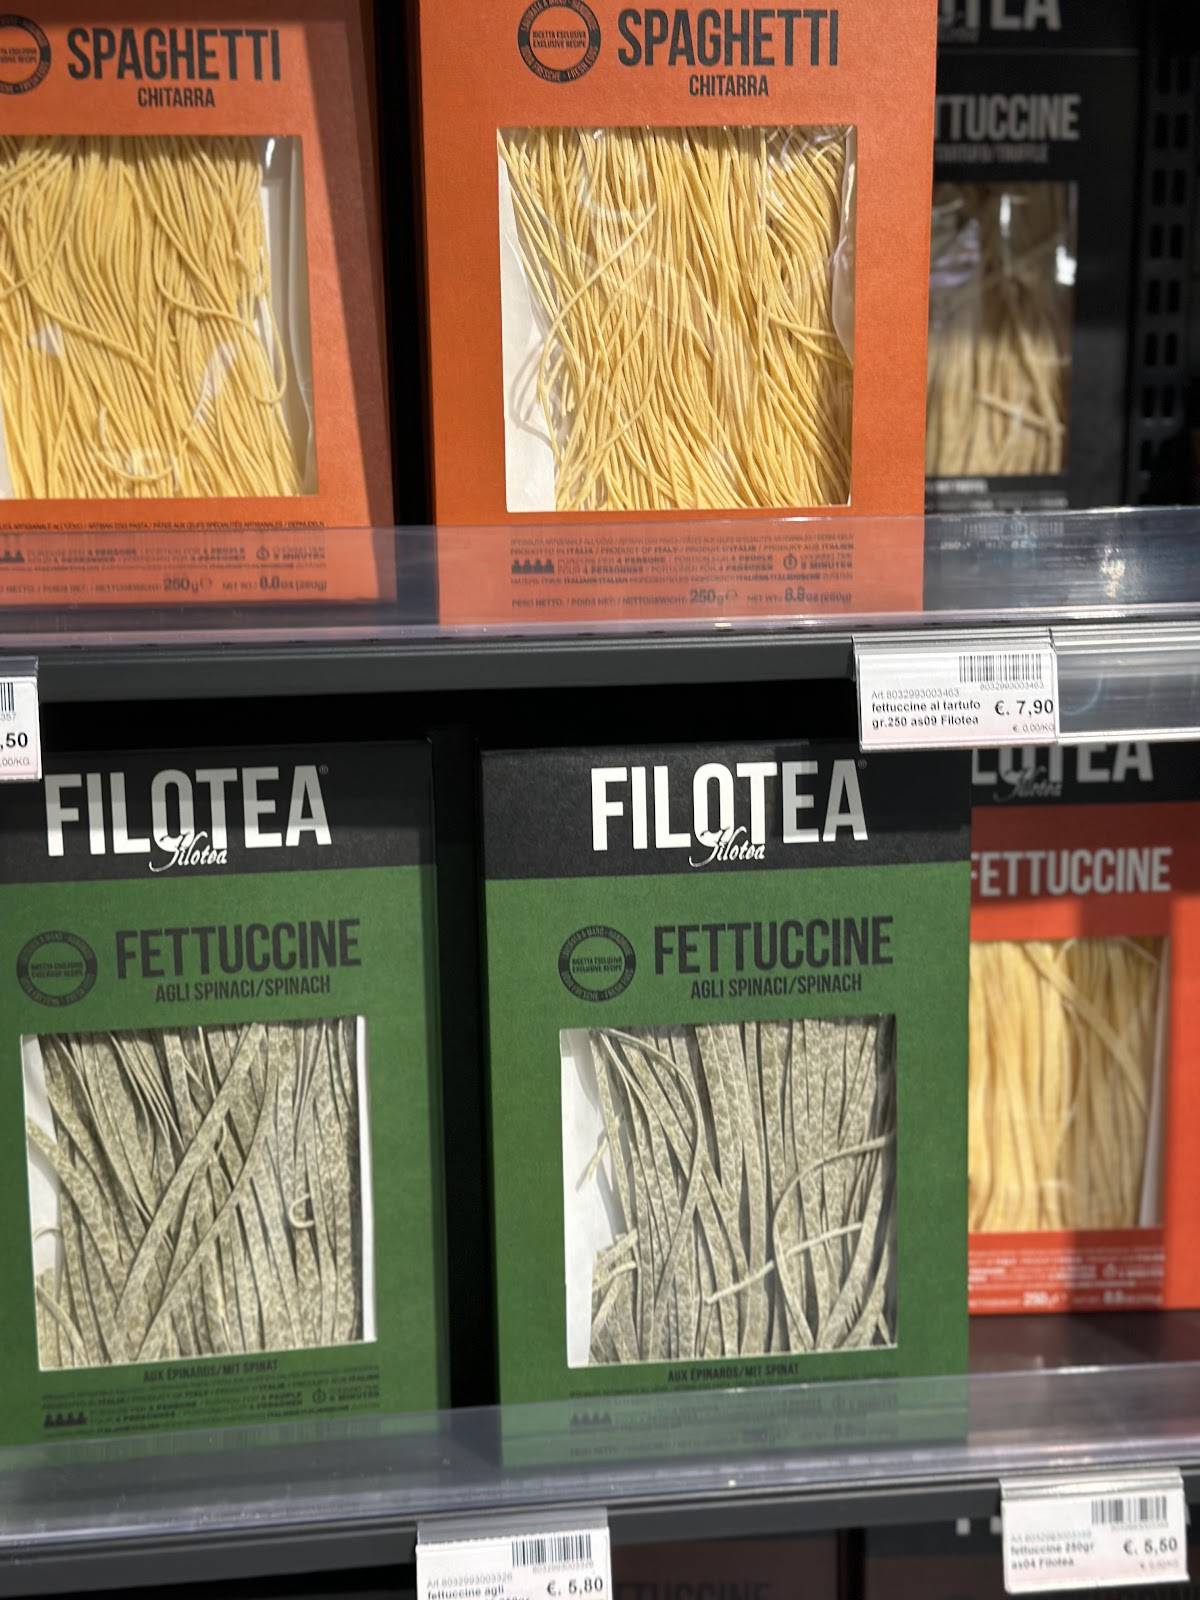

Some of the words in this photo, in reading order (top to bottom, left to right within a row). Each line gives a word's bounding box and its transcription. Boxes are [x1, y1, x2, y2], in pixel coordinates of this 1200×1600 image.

[616, 8, 838, 68] SPAGHETTI
[68, 27, 281, 81] SPAGHETTI
[137, 87, 216, 108] CHITARRA
[688, 75, 769, 97] CHITARRA
[872, 702, 927, 713] fettuccine
[930, 701, 941, 711] al
[943, 699, 981, 711] tartufo
[1016, 698, 1054, 718] 7,90
[872, 716, 907, 731] gr.250
[911, 715, 937, 727] as09
[941, 713, 979, 726] Filotea
[44, 765, 333, 857] FILOTEA
[591, 759, 869, 851] FILOTEA
[149, 831, 228, 872] Filotea
[689, 826, 766, 867] Filotea
[115, 918, 362, 980] FETTUCCINE
[653, 915, 894, 976] FETTUCCINE
[155, 982, 190, 1003] AGLI
[194, 974, 331, 1001] SPINACI/SPINACH
[691, 977, 724, 1000] AGLI
[729, 973, 862, 997] SPINACI/SPINACH
[668, 1367, 688, 1382] AUX
[428, 1588, 481, 1600] fettuccine
[484, 1584, 504, 1597] agli
